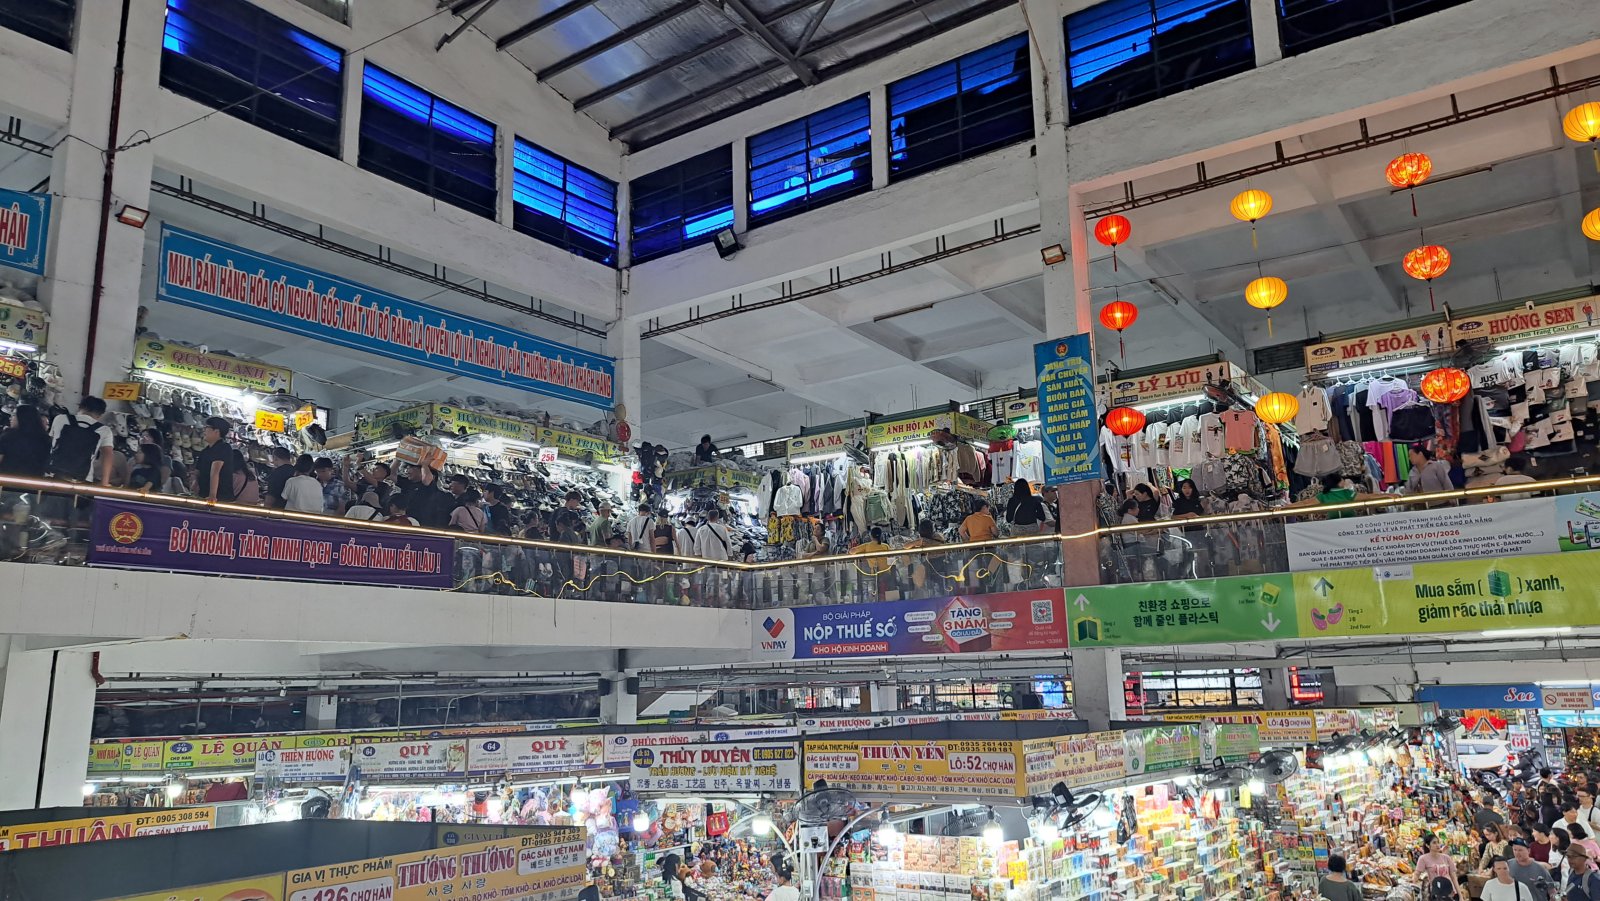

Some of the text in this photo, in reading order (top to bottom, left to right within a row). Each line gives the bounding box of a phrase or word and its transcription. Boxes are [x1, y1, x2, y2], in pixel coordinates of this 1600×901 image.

[167, 250, 193, 290] MUA
[194, 254, 218, 296] BÁN
[218, 260, 248, 304] HÀNG
[248, 269, 270, 310] HÓA
[270, 276, 286, 314] CÓ
[286, 280, 320, 323] NGUỒN
[320, 287, 340, 328] GỐC
[340, 294, 363, 334] XUẤT
[363, 302, 378, 338] XỨ
[376, 306, 390, 342] RÕ
[390, 309, 413, 347] RÀNG
[414, 316, 424, 350] LÀ
[424, 319, 450, 359] QUYỀN
[450, 329, 463, 366] LỢI
[464, 330, 474, 363] VÀ
[474, 336, 497, 370] NGHĨA
[497, 344, 508, 378] VỤ
[508, 341, 522, 376] CỦA
[566, 358, 574, 389] VÀ
[574, 362, 595, 394] KHÁCH
[595, 366, 612, 398] HÀNG
[1488, 306, 1575, 334] HƯƠNG SEN
[1341, 334, 1417, 359] MỸ HÒA
[1138, 370, 1200, 392] LÝ LỰU
[1480, 372, 1498, 384] JUST
[108, 388, 134, 398] 257
[261, 418, 278, 429] 257
[298, 412, 312, 426] 257
[810, 434, 842, 448] NA NA
[542, 454, 554, 462] 256
[1370, 530, 1460, 543] KỂ TỪ NGÀY 01/01/2026
[170, 520, 189, 552] BỎ
[190, 527, 236, 560] KHOÁN,
[239, 530, 270, 560] TĂNG
[270, 537, 301, 562] MINH
[302, 540, 332, 568] BẠCH
[369, 543, 396, 570] HÀNH
[418, 548, 435, 573] LÂU
[1416, 584, 1444, 598] Mua
[1448, 578, 1475, 596] sắm
[1526, 574, 1564, 592] xanh,
[1138, 598, 1210, 612] 친환경 쇼핑으로
[1418, 599, 1543, 623] giảm rác thải nhựa
[823, 610, 870, 620] BỘ GIẢI PHÁP
[950, 608, 980, 620] TẶNG
[1133, 612, 1219, 627] 함께 줄인 플라스틱
[804, 622, 833, 644] NỘP
[836, 618, 874, 639] THUẾ
[876, 616, 898, 637] SỐ
[944, 621, 952, 631] 3
[954, 616, 988, 630] NĂM
[761, 640, 788, 650] VNPAY
[814, 644, 886, 654] CHO HỘ KINH DOANH
[1504, 687, 1536, 702] See
[820, 718, 871, 728] KIM PHƯỢNG
[486, 742, 496, 750] 64
[1512, 736, 1528, 748] 60
[660, 746, 750, 764] THÙY DUYÊN
[861, 741, 946, 762] THUẬN YẾN
[983, 761, 998, 773] CHỢ
[999, 760, 1014, 770] HÀN
[136, 818, 154, 826] ĐT:
[156, 814, 176, 823] 0905
[195, 810, 209, 819] 594
[522, 844, 584, 862] ĐẶC SẢN VIỆT NAM
[292, 857, 392, 884] GIA VỊ THỰC PHẨM
